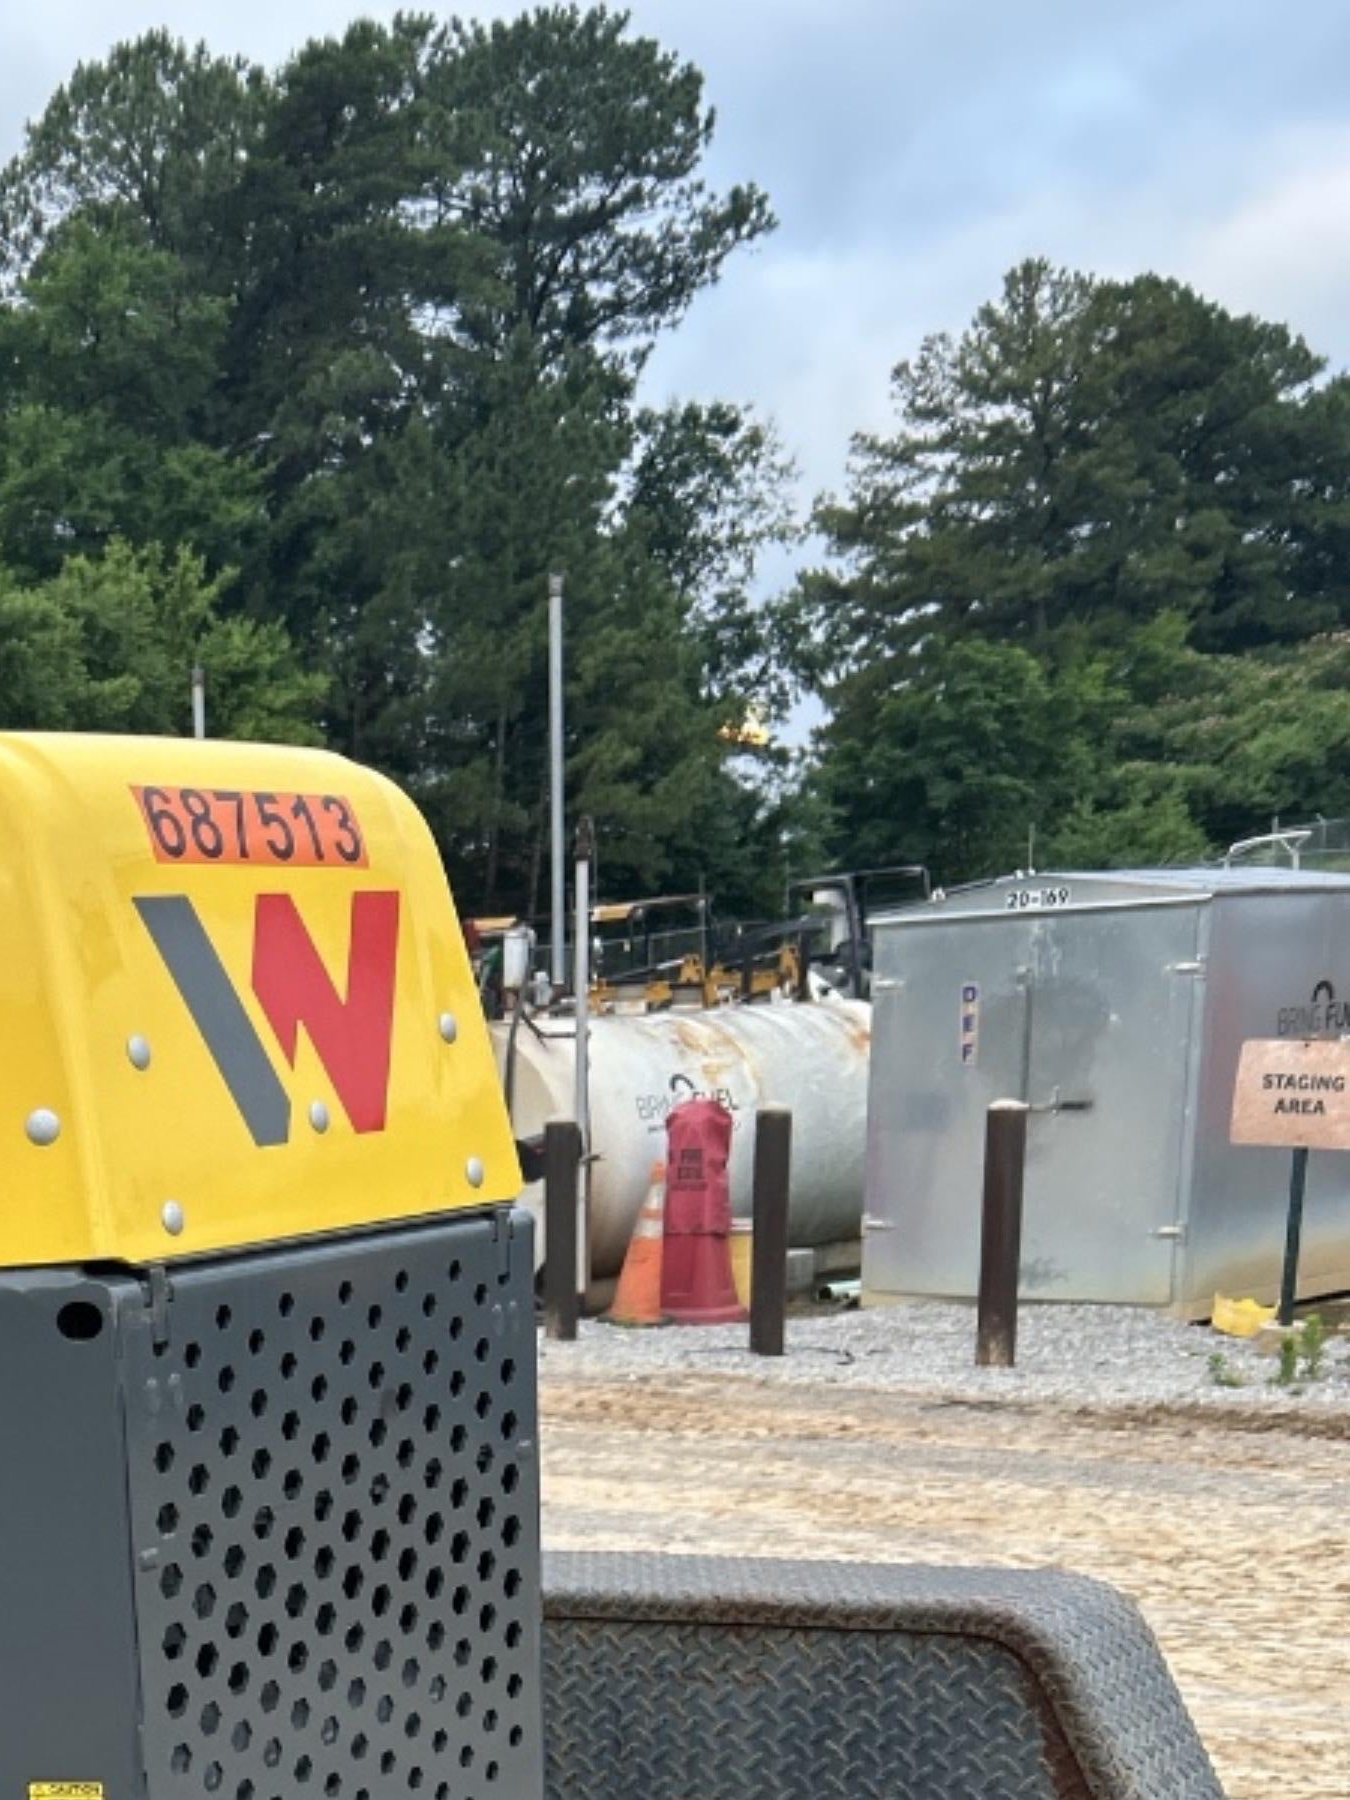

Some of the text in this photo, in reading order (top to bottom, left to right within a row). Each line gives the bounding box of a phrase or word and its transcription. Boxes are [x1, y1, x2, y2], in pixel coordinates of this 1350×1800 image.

[144, 786, 362, 862] 687513
[1262, 1073, 1346, 1093] STAGING
[1274, 1098, 1326, 1115] AREA
